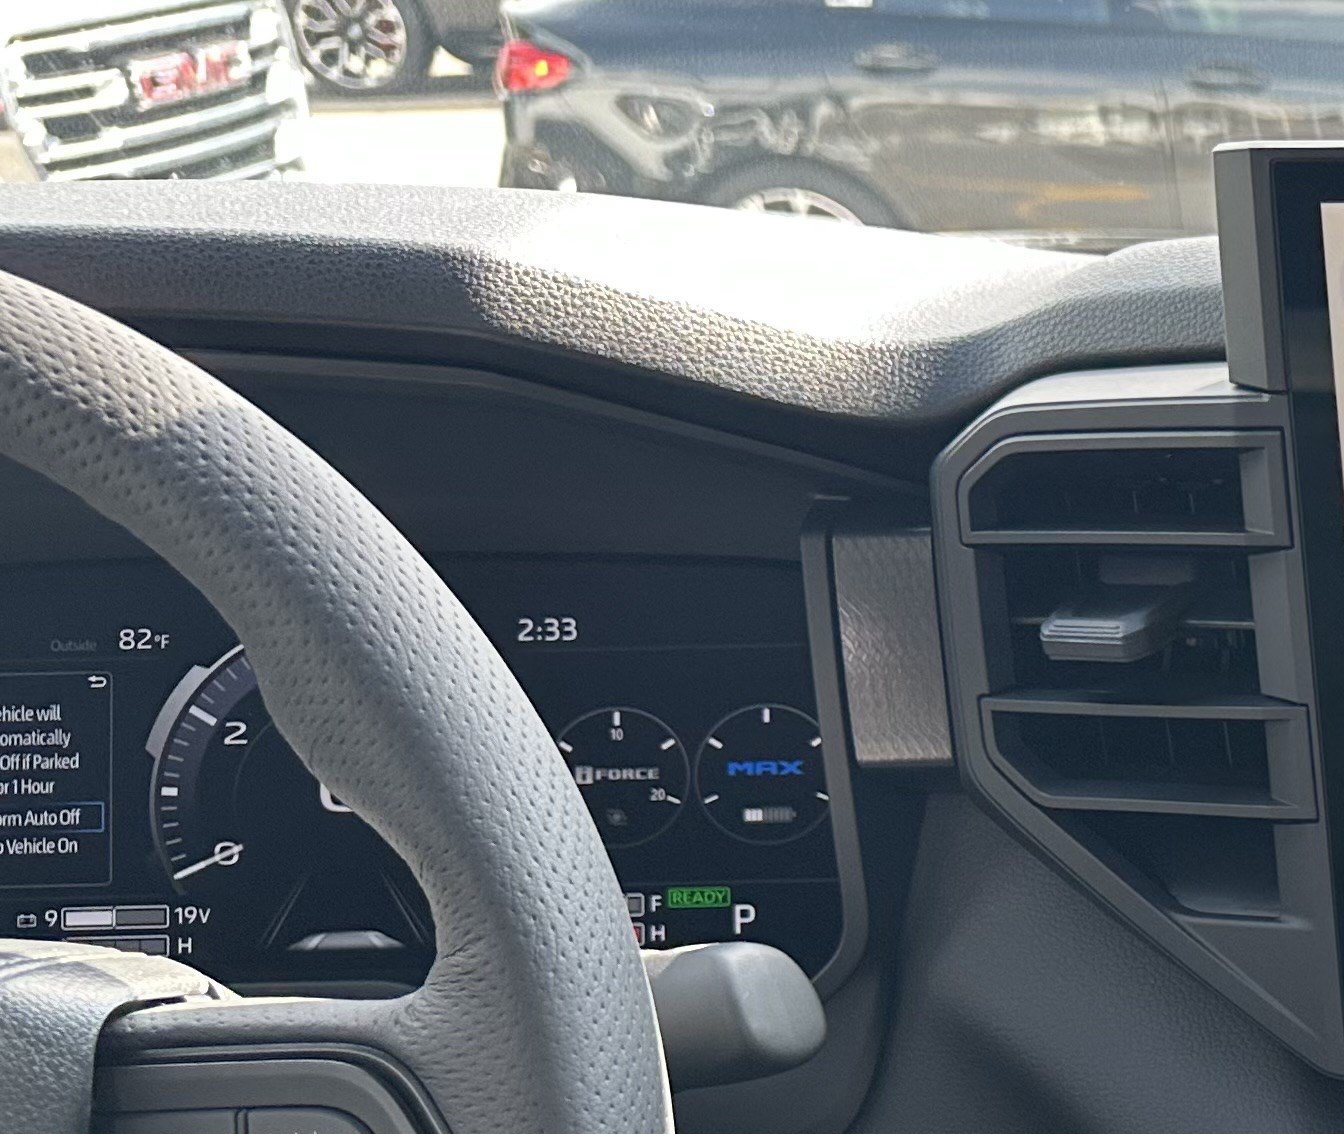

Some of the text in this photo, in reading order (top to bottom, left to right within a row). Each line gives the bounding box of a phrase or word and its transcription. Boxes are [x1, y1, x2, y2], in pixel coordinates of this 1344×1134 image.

[517, 618, 578, 642] 2:33
[36, 704, 61, 721] will
[223, 721, 249, 746] 2
[610, 728, 624, 741] 10
[1, 752, 80, 771] Off if Parked
[727, 760, 804, 776] MAX
[21, 778, 55, 794] Hour
[650, 788, 666, 801] 20
[24, 810, 58, 826] Auto
[60, 808, 81, 825] Off
[6, 838, 56, 855] Vehicle
[58, 837, 78, 854] On
[650, 895, 663, 913] F
[672, 890, 727, 905] READY
[44, 907, 211, 927] 9 19V
[734, 904, 756, 935] P
[650, 925, 666, 941] H
[178, 938, 193, 955] H
